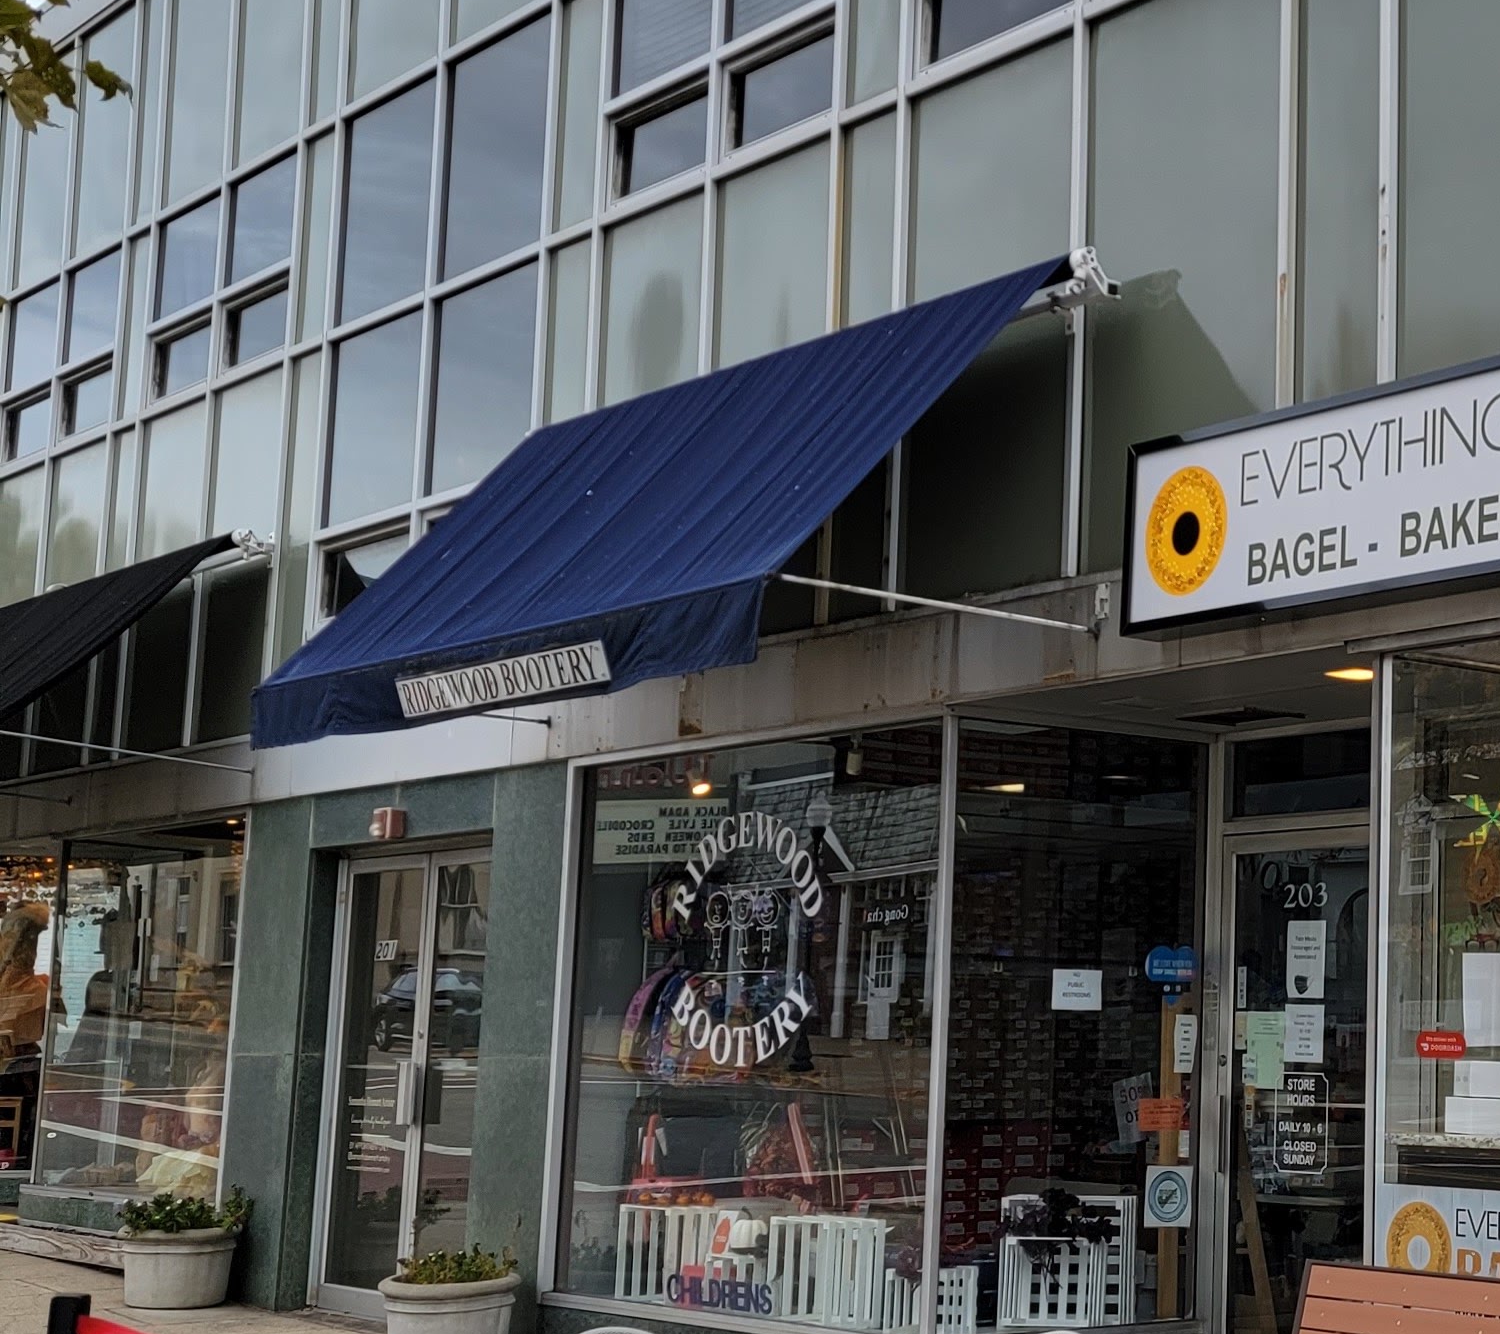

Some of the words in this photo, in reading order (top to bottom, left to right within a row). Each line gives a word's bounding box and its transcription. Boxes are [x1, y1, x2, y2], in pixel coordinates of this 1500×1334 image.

[1248, 525, 1357, 586] BAGEL
[402, 667, 498, 715] RIDGEWOOD
[498, 645, 598, 695] BOOTERY
[673, 811, 822, 923] RIDGEWOOD
[1284, 882, 1328, 908] 203
[376, 942, 394, 959] 201
[671, 971, 813, 1067] BOOTERY
[1287, 1079, 1315, 1091] STORE
[1287, 1095, 1315, 1106] HOURS
[1278, 1121, 1301, 1132] DAILY
[1303, 1123, 1311, 1132] 10
[1317, 1123, 1322, 1133] 6
[1283, 1140, 1316, 1152] CLOSED
[1283, 1154, 1315, 1165] SUNDAY
[666, 1273, 773, 1315] CHILDRENS
